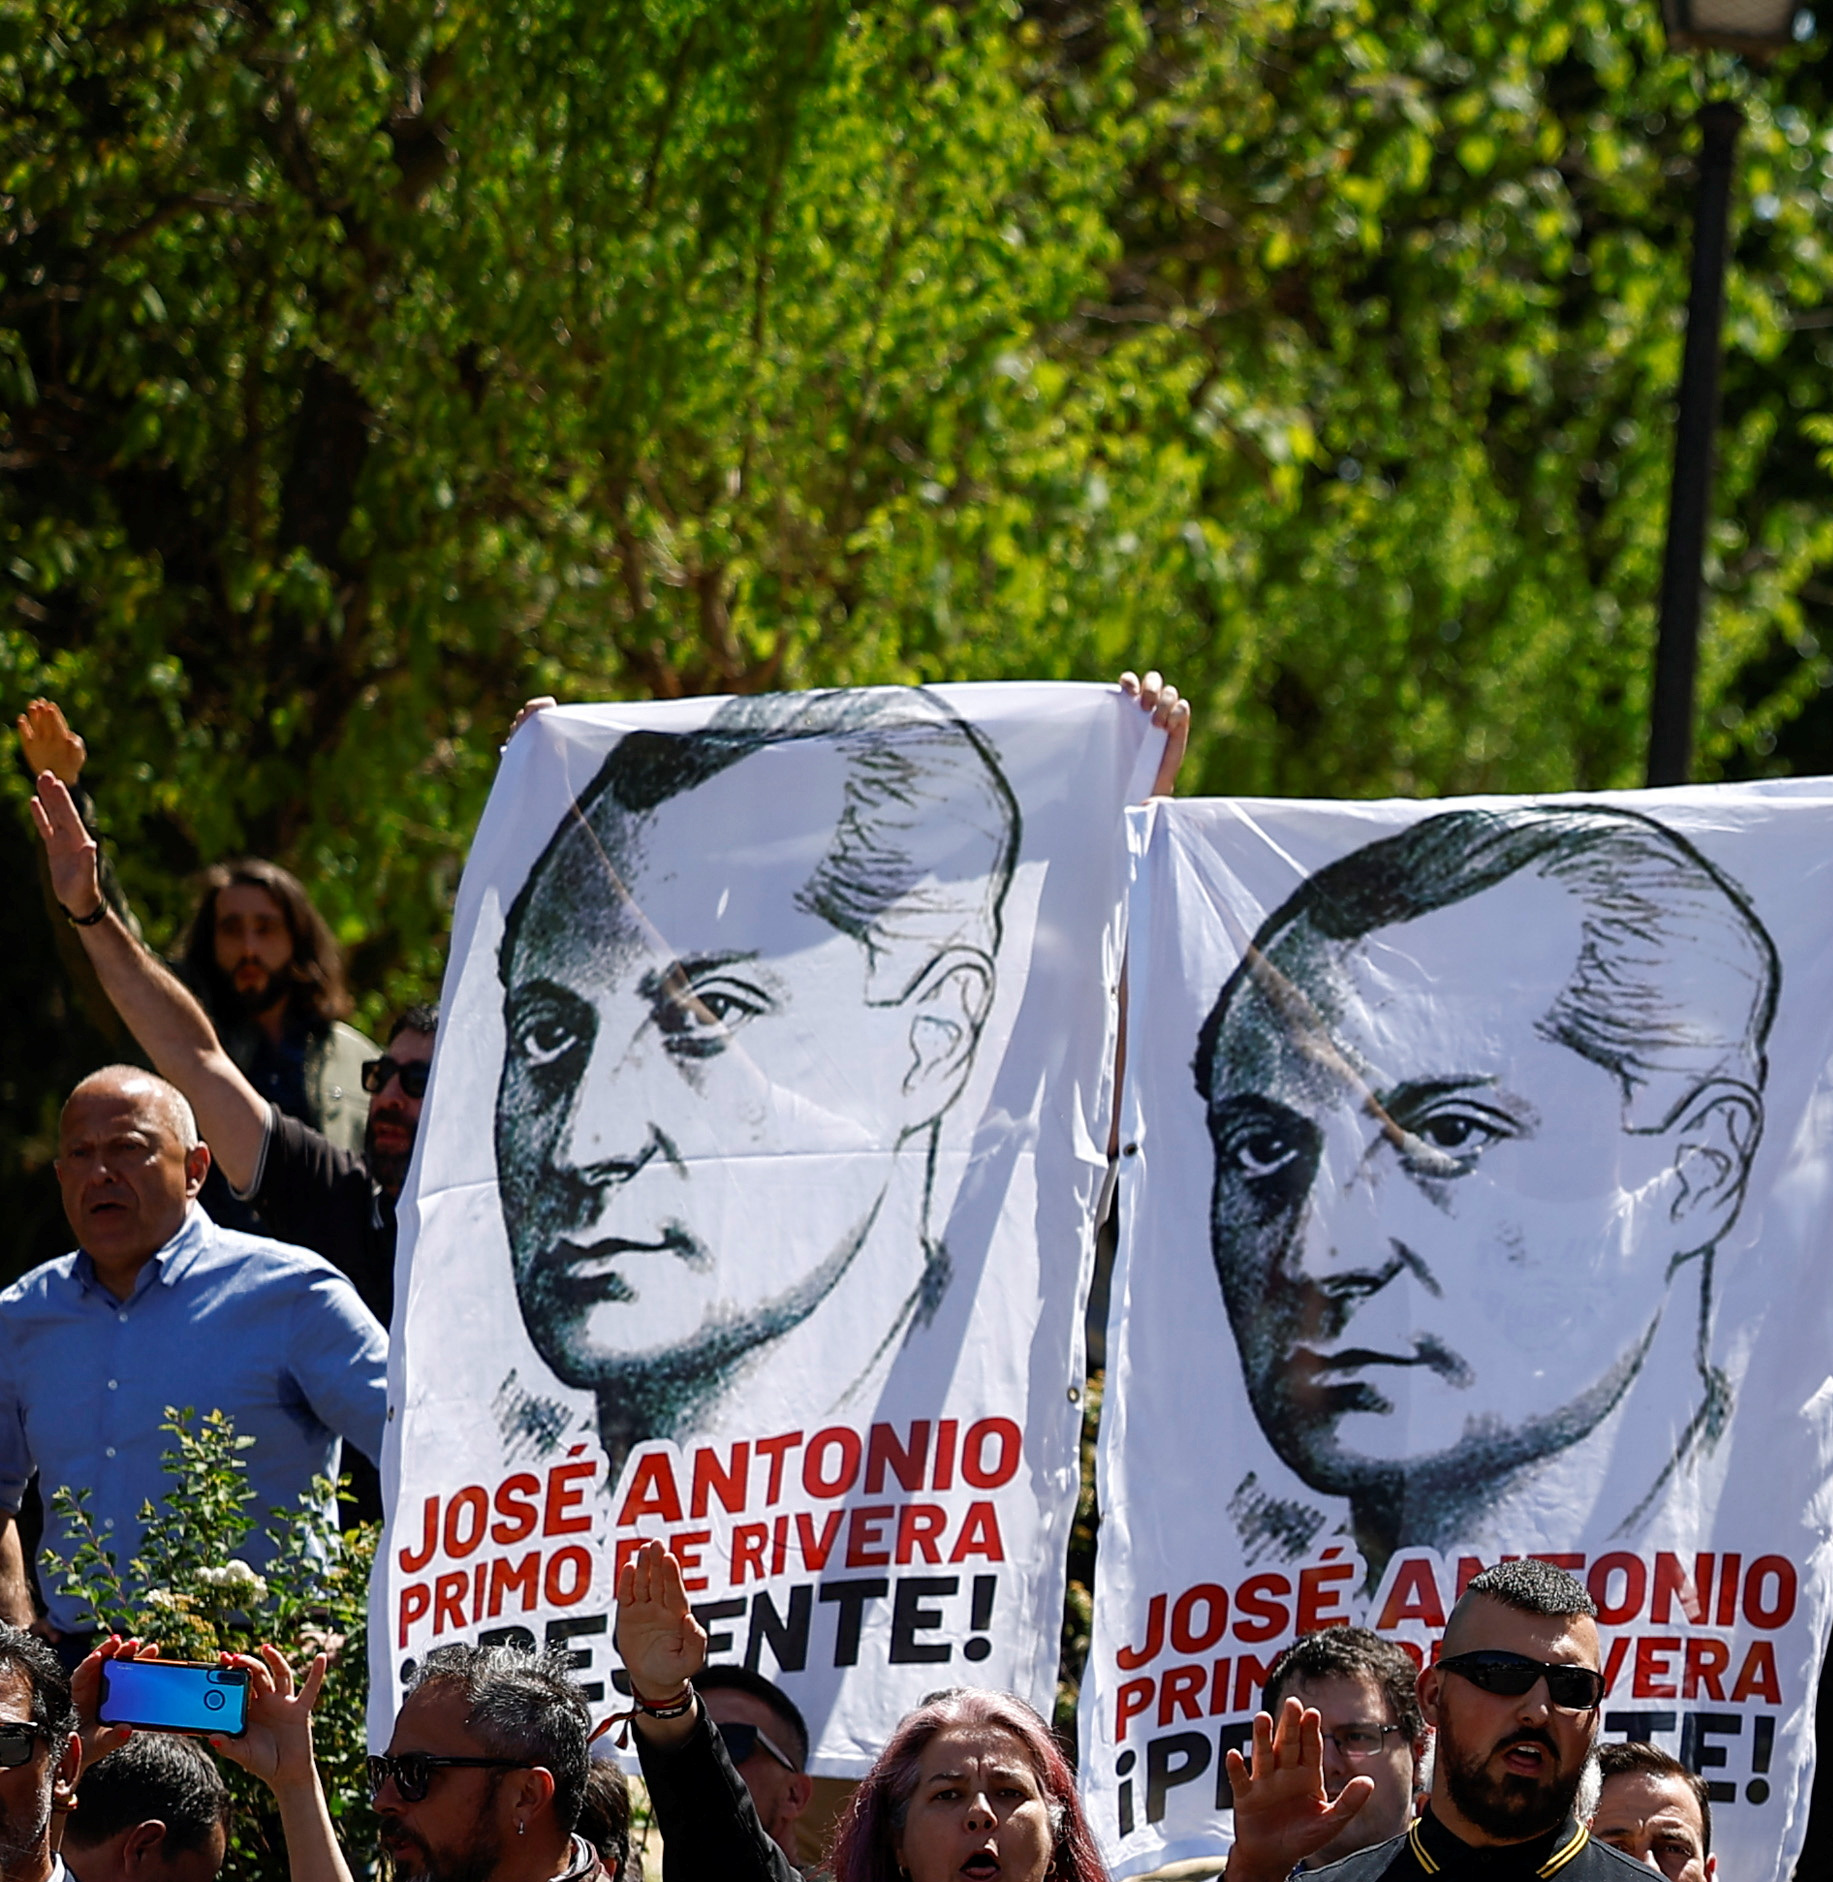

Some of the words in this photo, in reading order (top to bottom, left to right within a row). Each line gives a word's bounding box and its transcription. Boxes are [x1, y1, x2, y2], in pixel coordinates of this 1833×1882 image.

[398, 1443, 598, 1574] JOSÉ
[616, 1417, 1023, 1526] ANTONIO
[398, 1543, 593, 1649] PRIMO
[730, 1501, 1004, 1584] RIVERA
[1115, 1546, 1355, 1672] JOSÉ
[1115, 1650, 1284, 1745] PRIM
